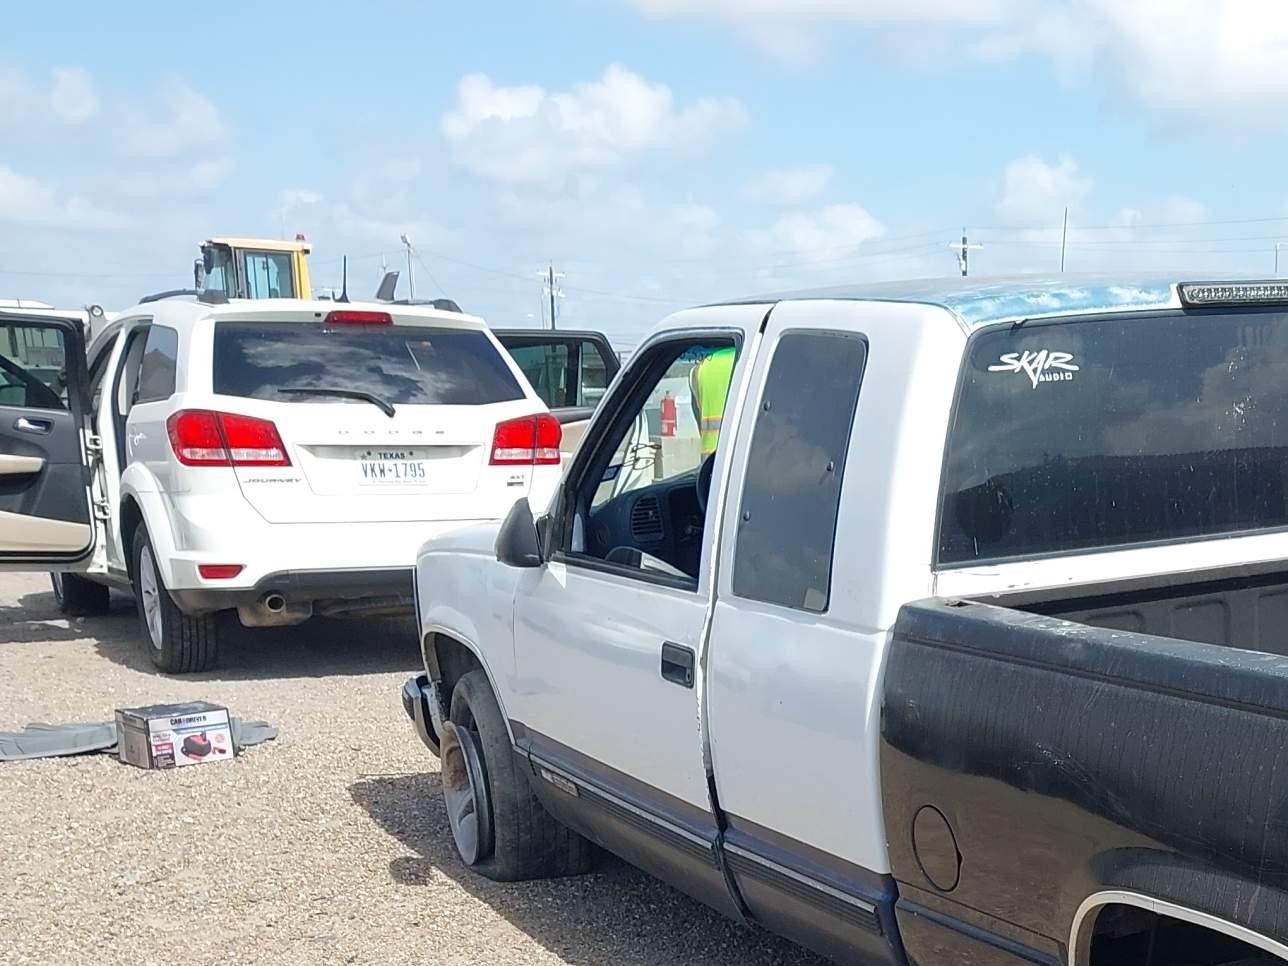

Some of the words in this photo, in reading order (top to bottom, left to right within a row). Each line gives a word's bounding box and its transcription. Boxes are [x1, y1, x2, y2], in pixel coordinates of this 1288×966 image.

[988, 349, 1080, 389] SKAR
[1039, 372, 1073, 382] AUDIO
[378, 451, 405, 460] TEXAS
[361, 462, 425, 478] VKW-1795
